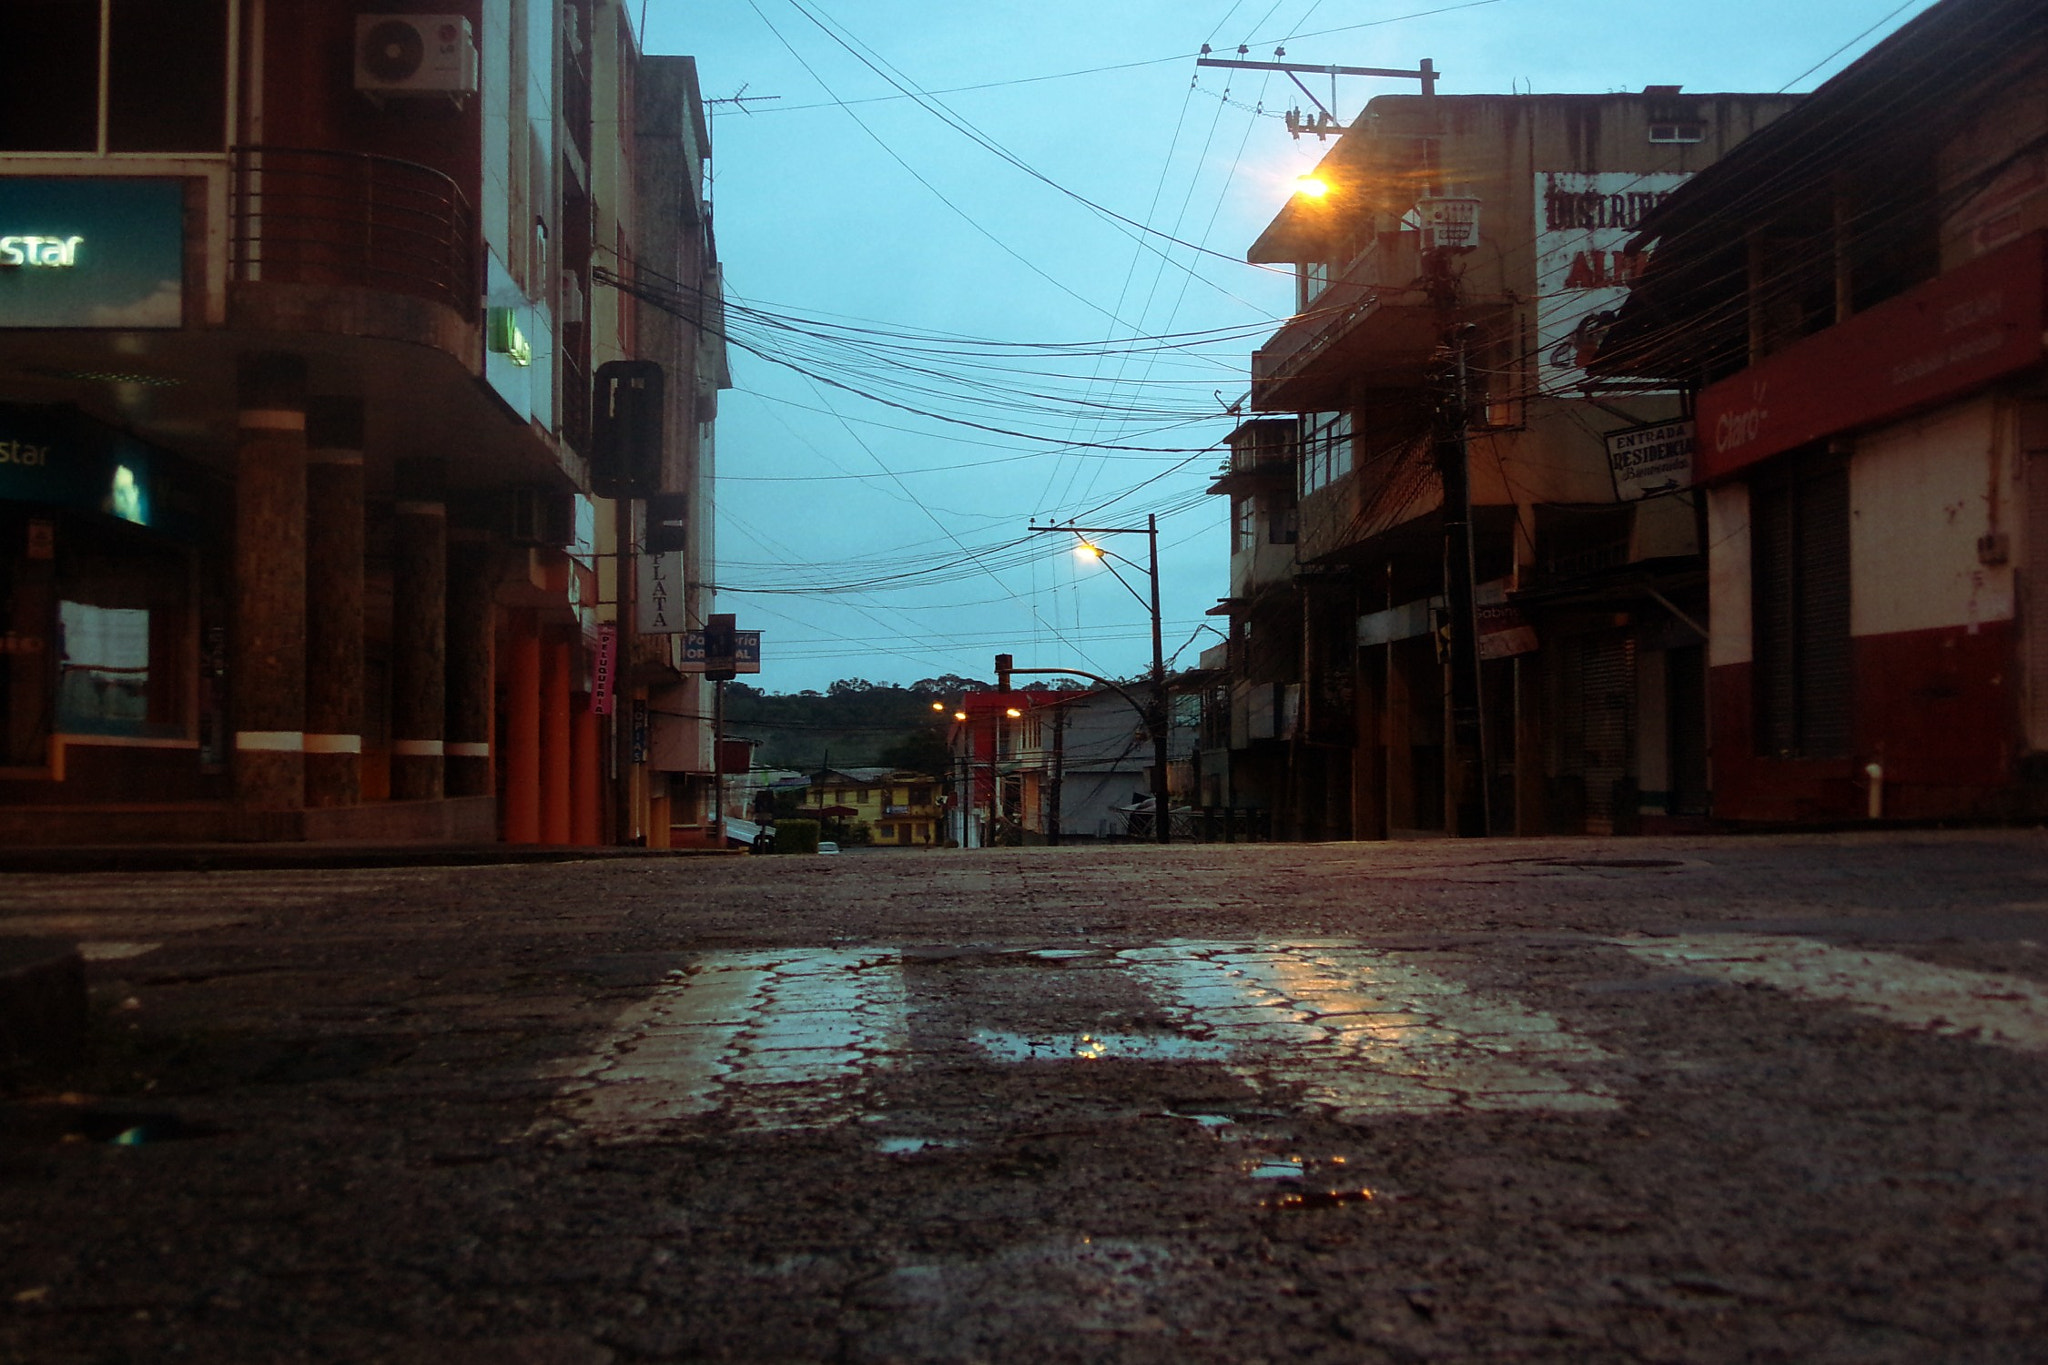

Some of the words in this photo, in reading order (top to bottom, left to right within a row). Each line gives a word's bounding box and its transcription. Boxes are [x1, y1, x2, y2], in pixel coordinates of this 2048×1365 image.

[1617, 425, 1686, 449] ENTRADA
[1716, 407, 1759, 452] Claro
[595, 636, 609, 713] PELUQUERIA
